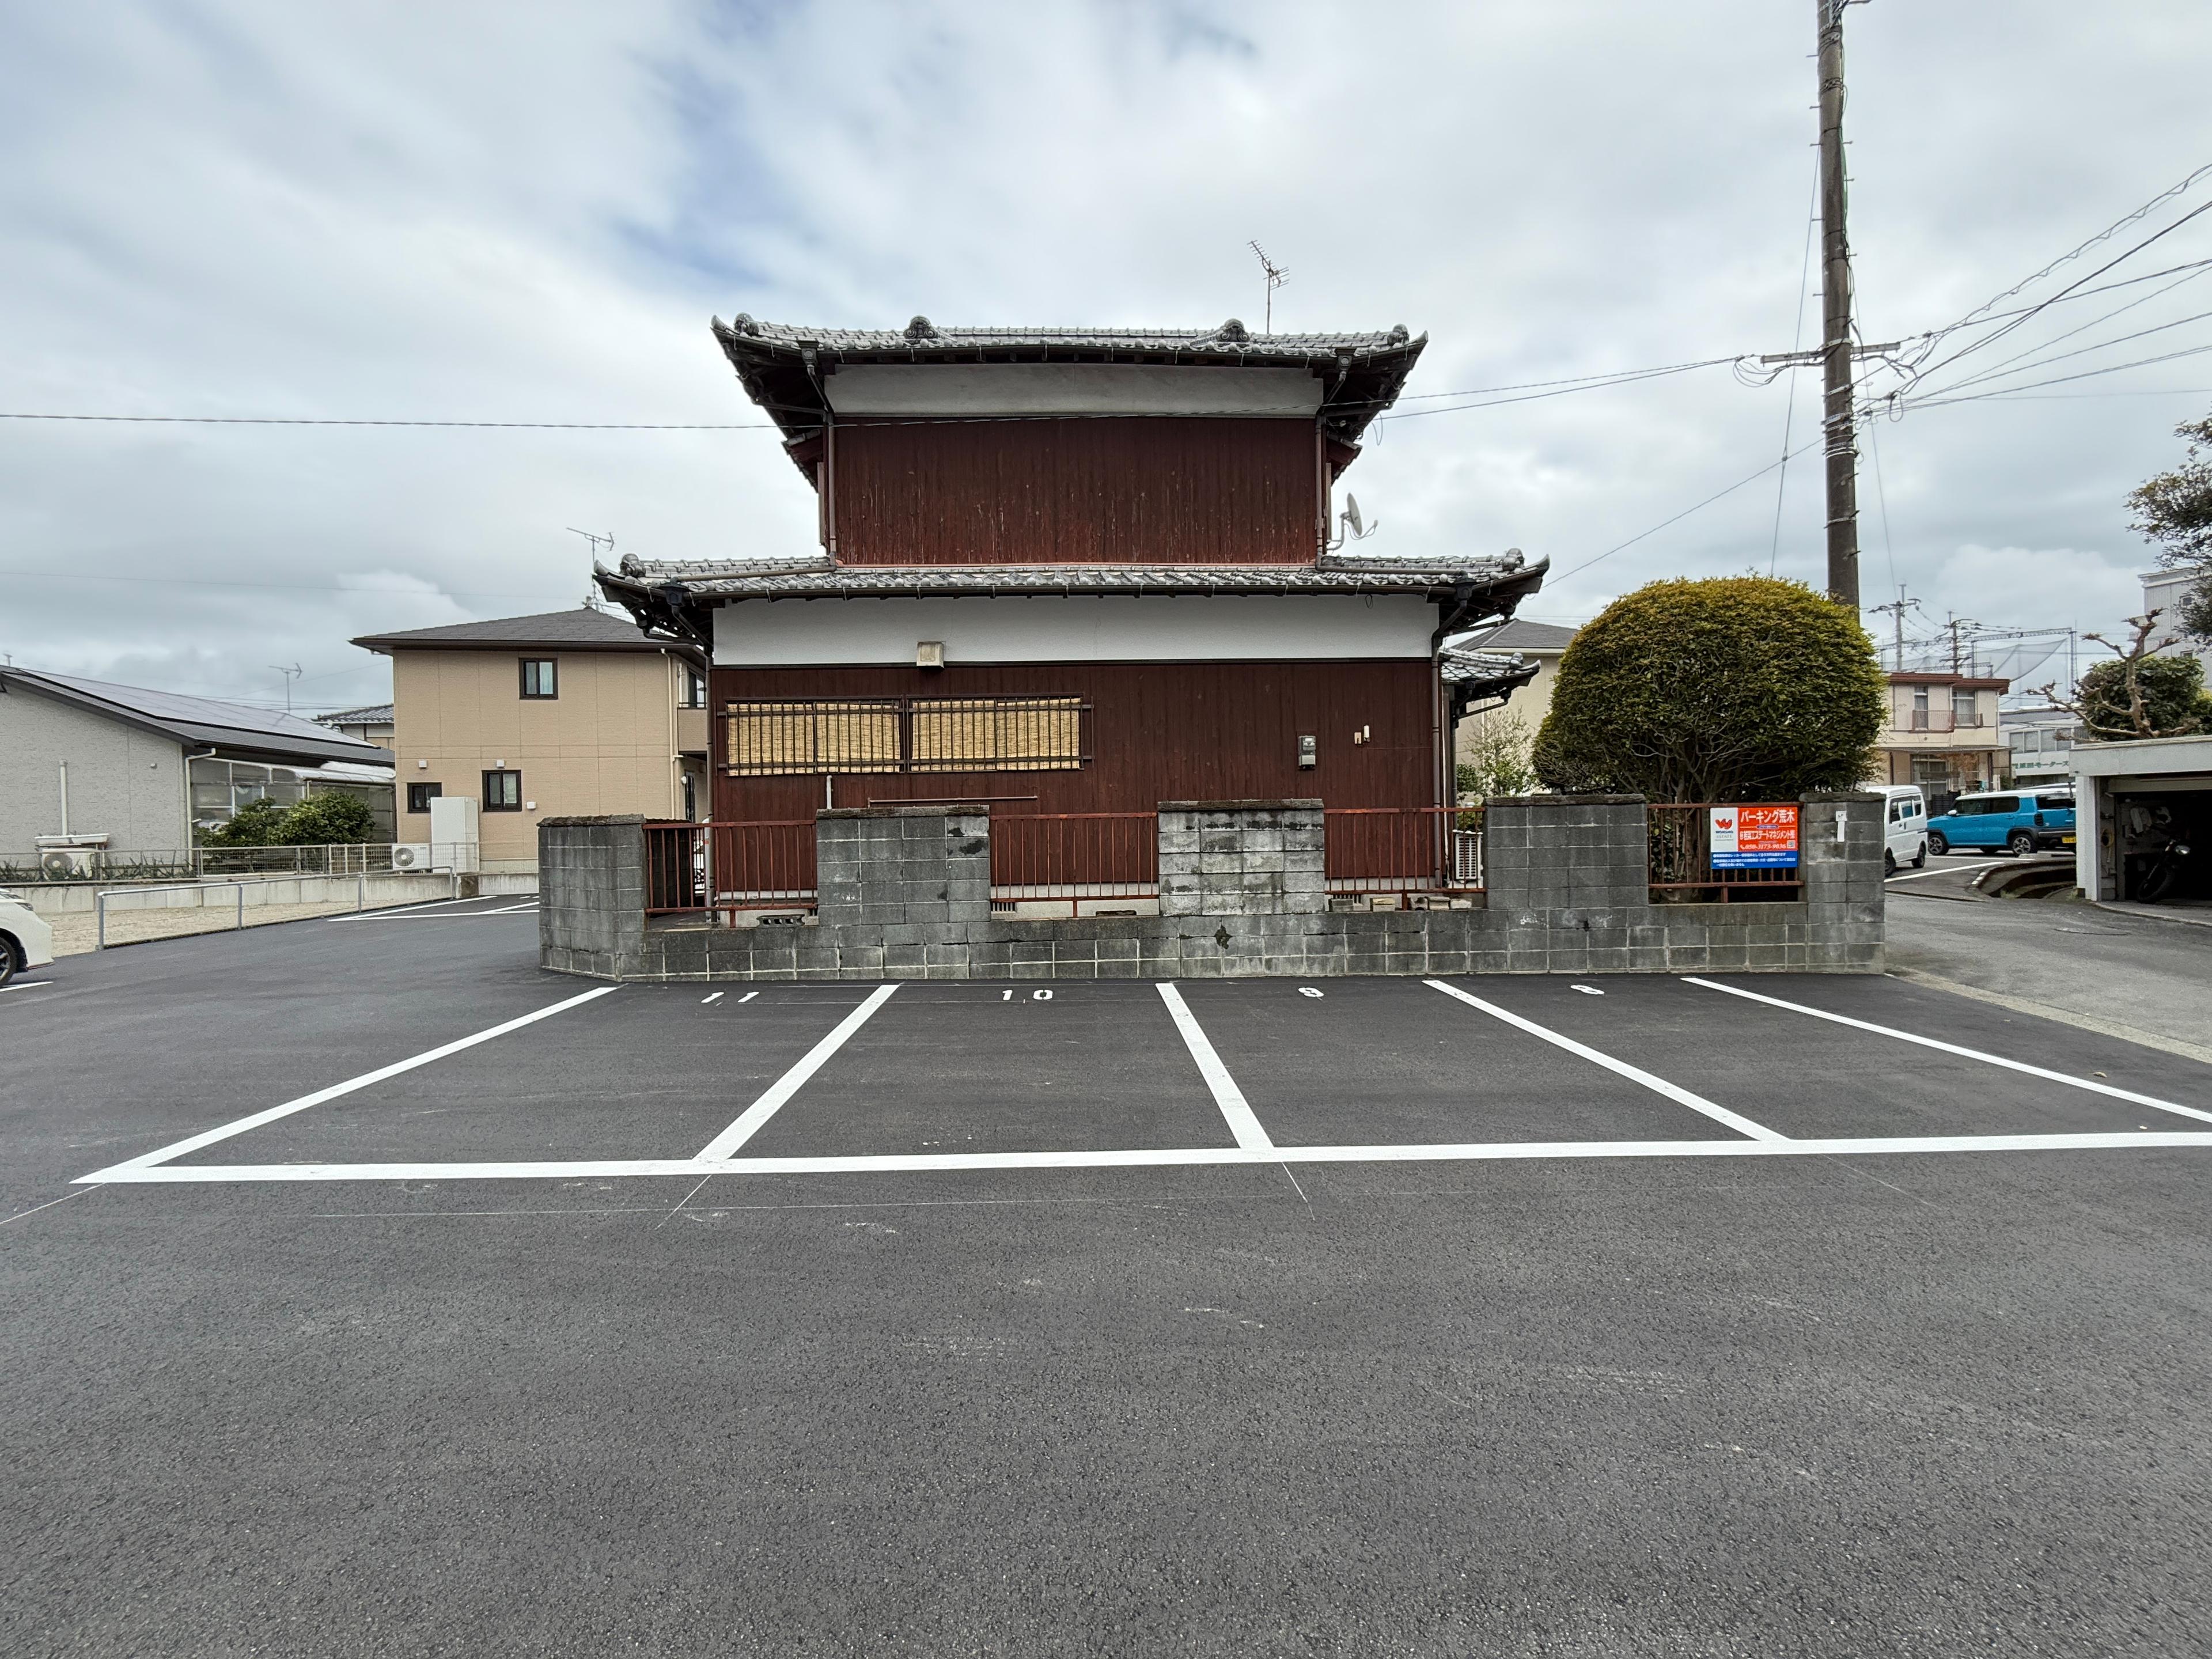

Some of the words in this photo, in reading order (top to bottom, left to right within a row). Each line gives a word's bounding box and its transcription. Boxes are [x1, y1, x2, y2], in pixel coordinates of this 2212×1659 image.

[1740, 808, 1795, 824] パーキング荒木
[1298, 987, 1324, 997] 9
[1570, 984, 1605, 995] 8
[701, 991, 760, 1003] 11
[1002, 990, 1053, 1001] 10
